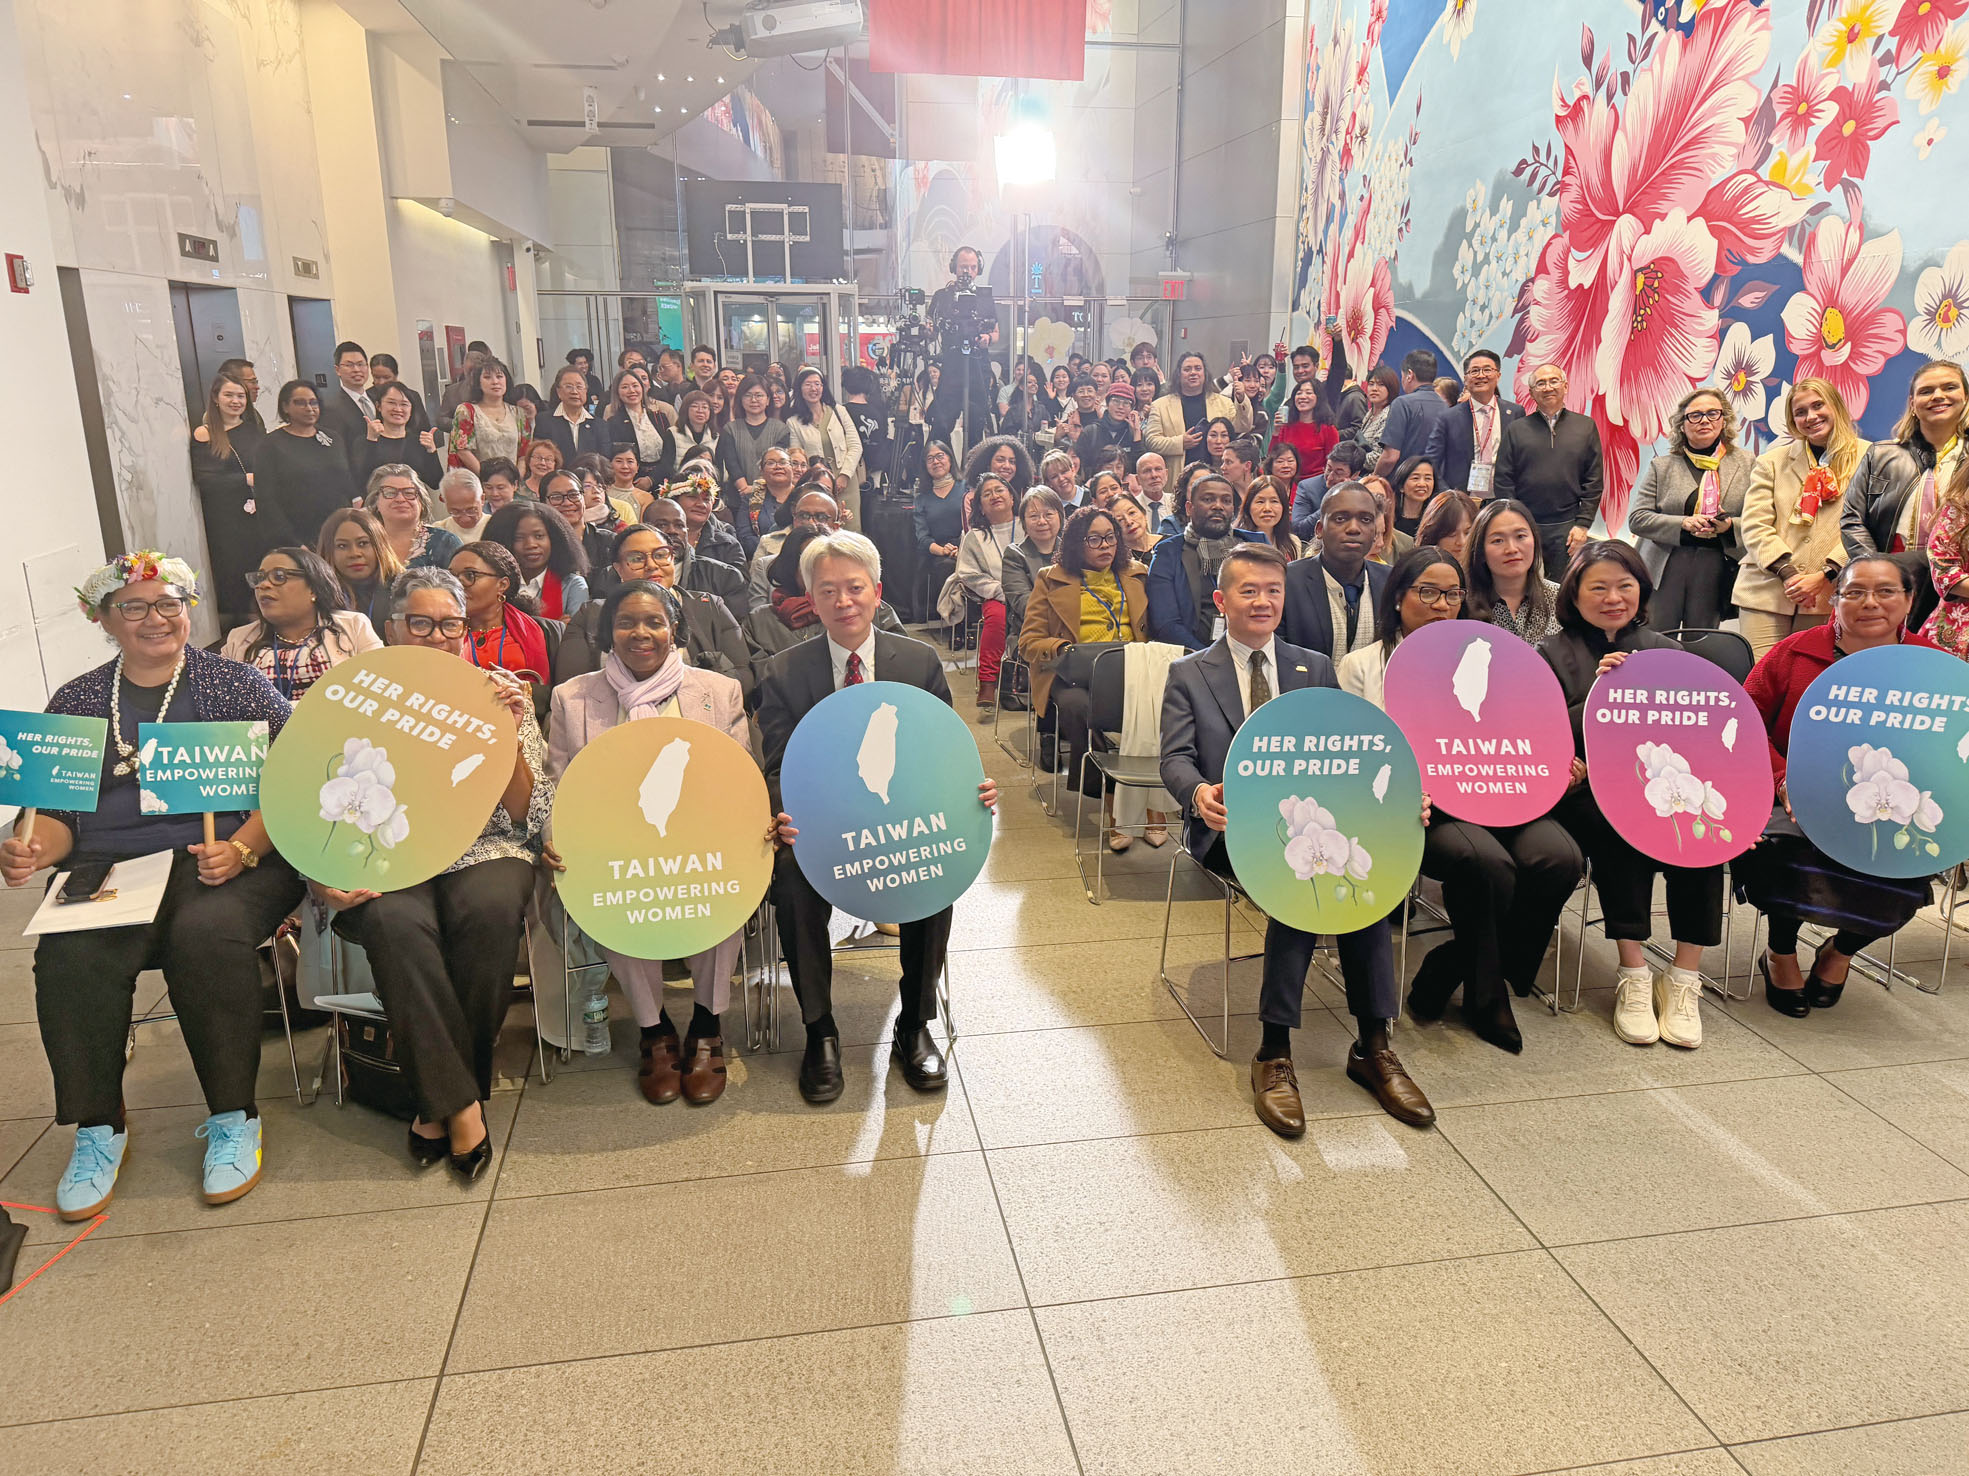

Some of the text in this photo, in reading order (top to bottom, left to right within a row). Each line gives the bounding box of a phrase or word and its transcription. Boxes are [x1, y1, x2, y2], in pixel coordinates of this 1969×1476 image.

[1163, 280, 1185, 299] EXIT
[1608, 688, 1737, 708] HER RIGHTS,
[1828, 684, 1878, 704] HER
[352, 669, 499, 745] HER RIGHTS,
[324, 684, 457, 750] OUR PRIDE
[1596, 708, 1709, 726] OUR PRIDE
[1808, 705, 1947, 733] OUR PRIDE
[17, 732, 94, 748] HER RIGHTS,
[1252, 734, 1392, 753] HER RIGHTS,
[1435, 738, 1533, 755] TAIWAN
[32, 745, 99, 758] OUR PRIDE
[157, 744, 269, 764] TAIWAN
[61, 770, 96, 779] TAIWAN
[146, 766, 262, 781] EMPOWERIN
[1237, 758, 1360, 776] OUR PRIDE
[1426, 763, 1550, 777] EMPOWERING
[50, 778, 95, 786] EMPOWERING
[199, 783, 257, 797] WOME
[1456, 781, 1528, 794] WOMEN
[841, 811, 948, 851] TAIWAN
[608, 851, 723, 880] TAIWAN
[833, 837, 967, 880] EMPOWERING
[866, 863, 944, 893] WOMEN
[592, 880, 741, 907] EMPOWERING
[626, 903, 711, 925] WOMEN
